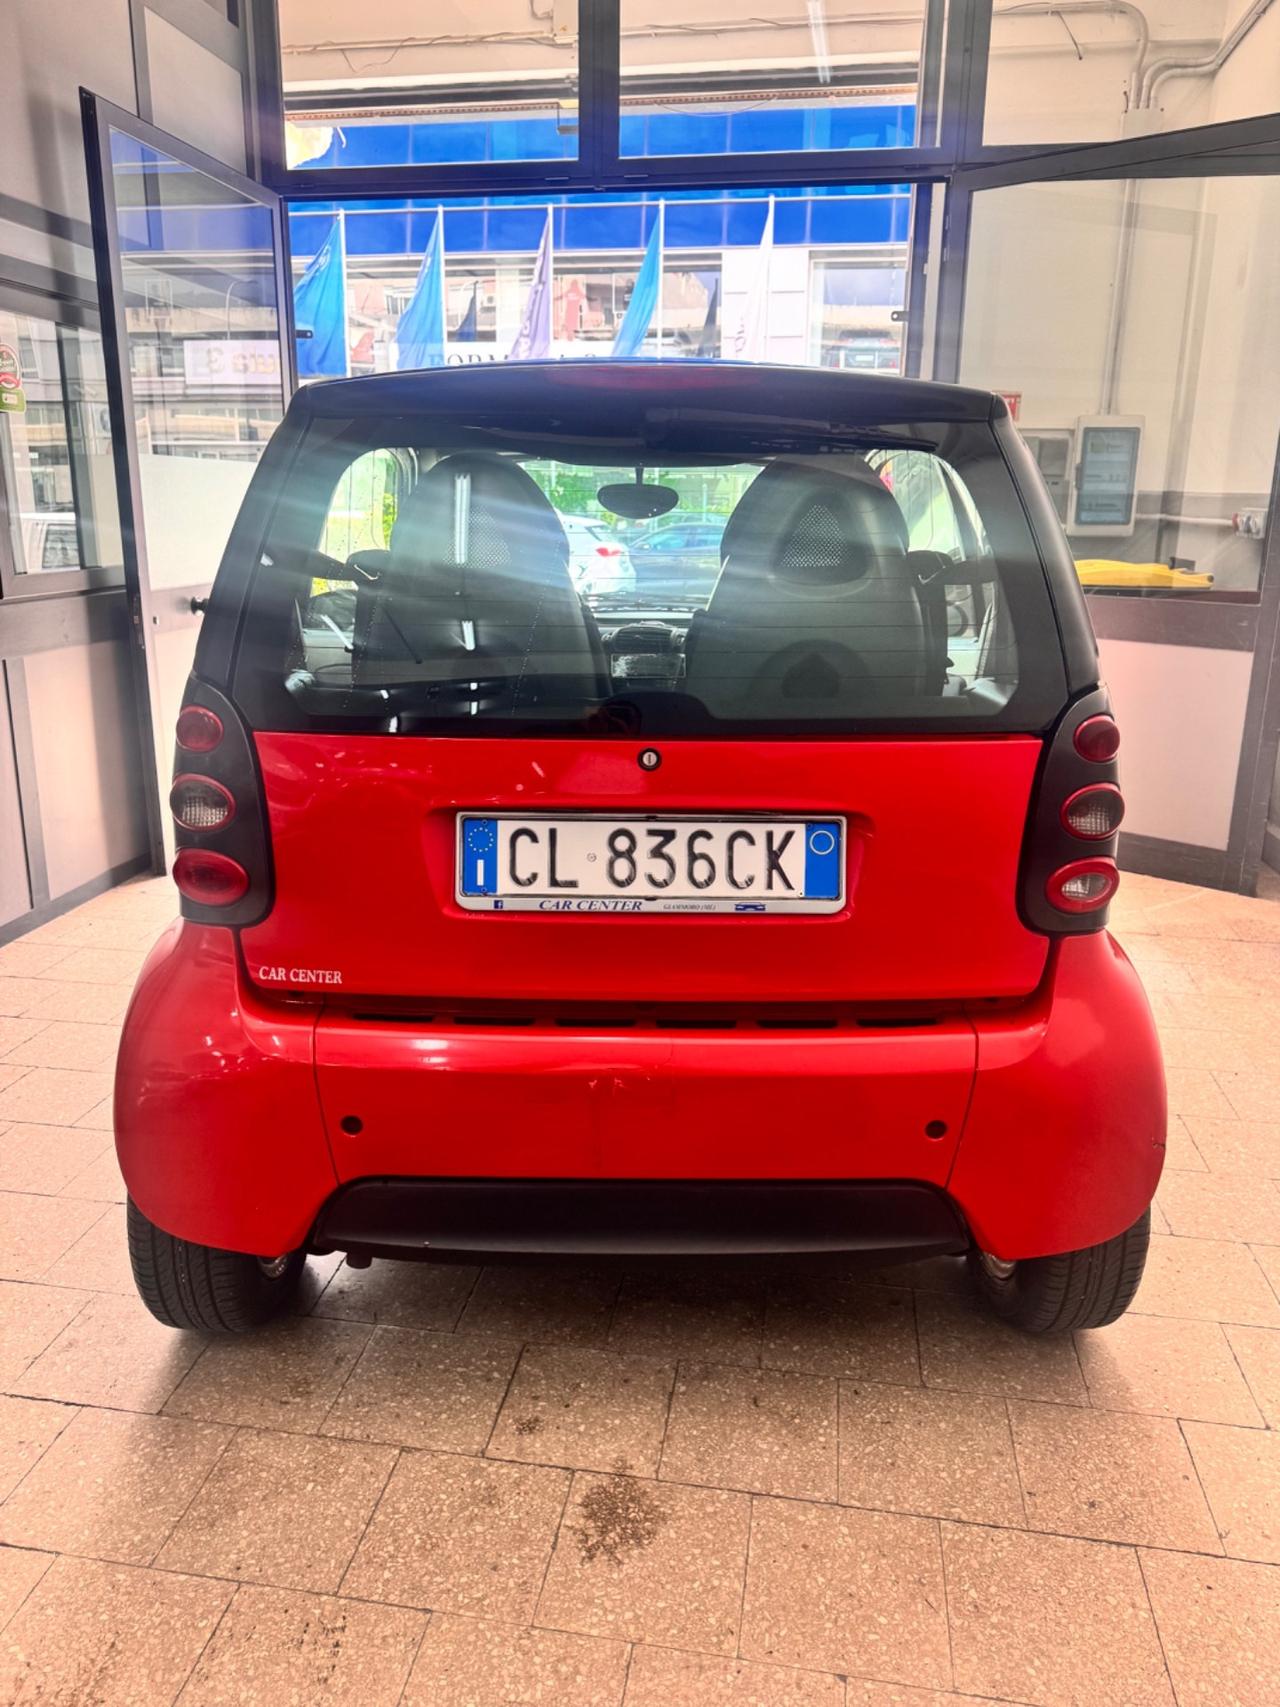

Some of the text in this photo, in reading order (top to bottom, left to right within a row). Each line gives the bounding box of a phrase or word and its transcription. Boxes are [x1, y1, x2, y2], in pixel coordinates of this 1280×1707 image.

[509, 827, 796, 890] CL 836CK
[539, 901, 643, 911] CAR CENTER
[259, 966, 343, 984] CAR CENTER
